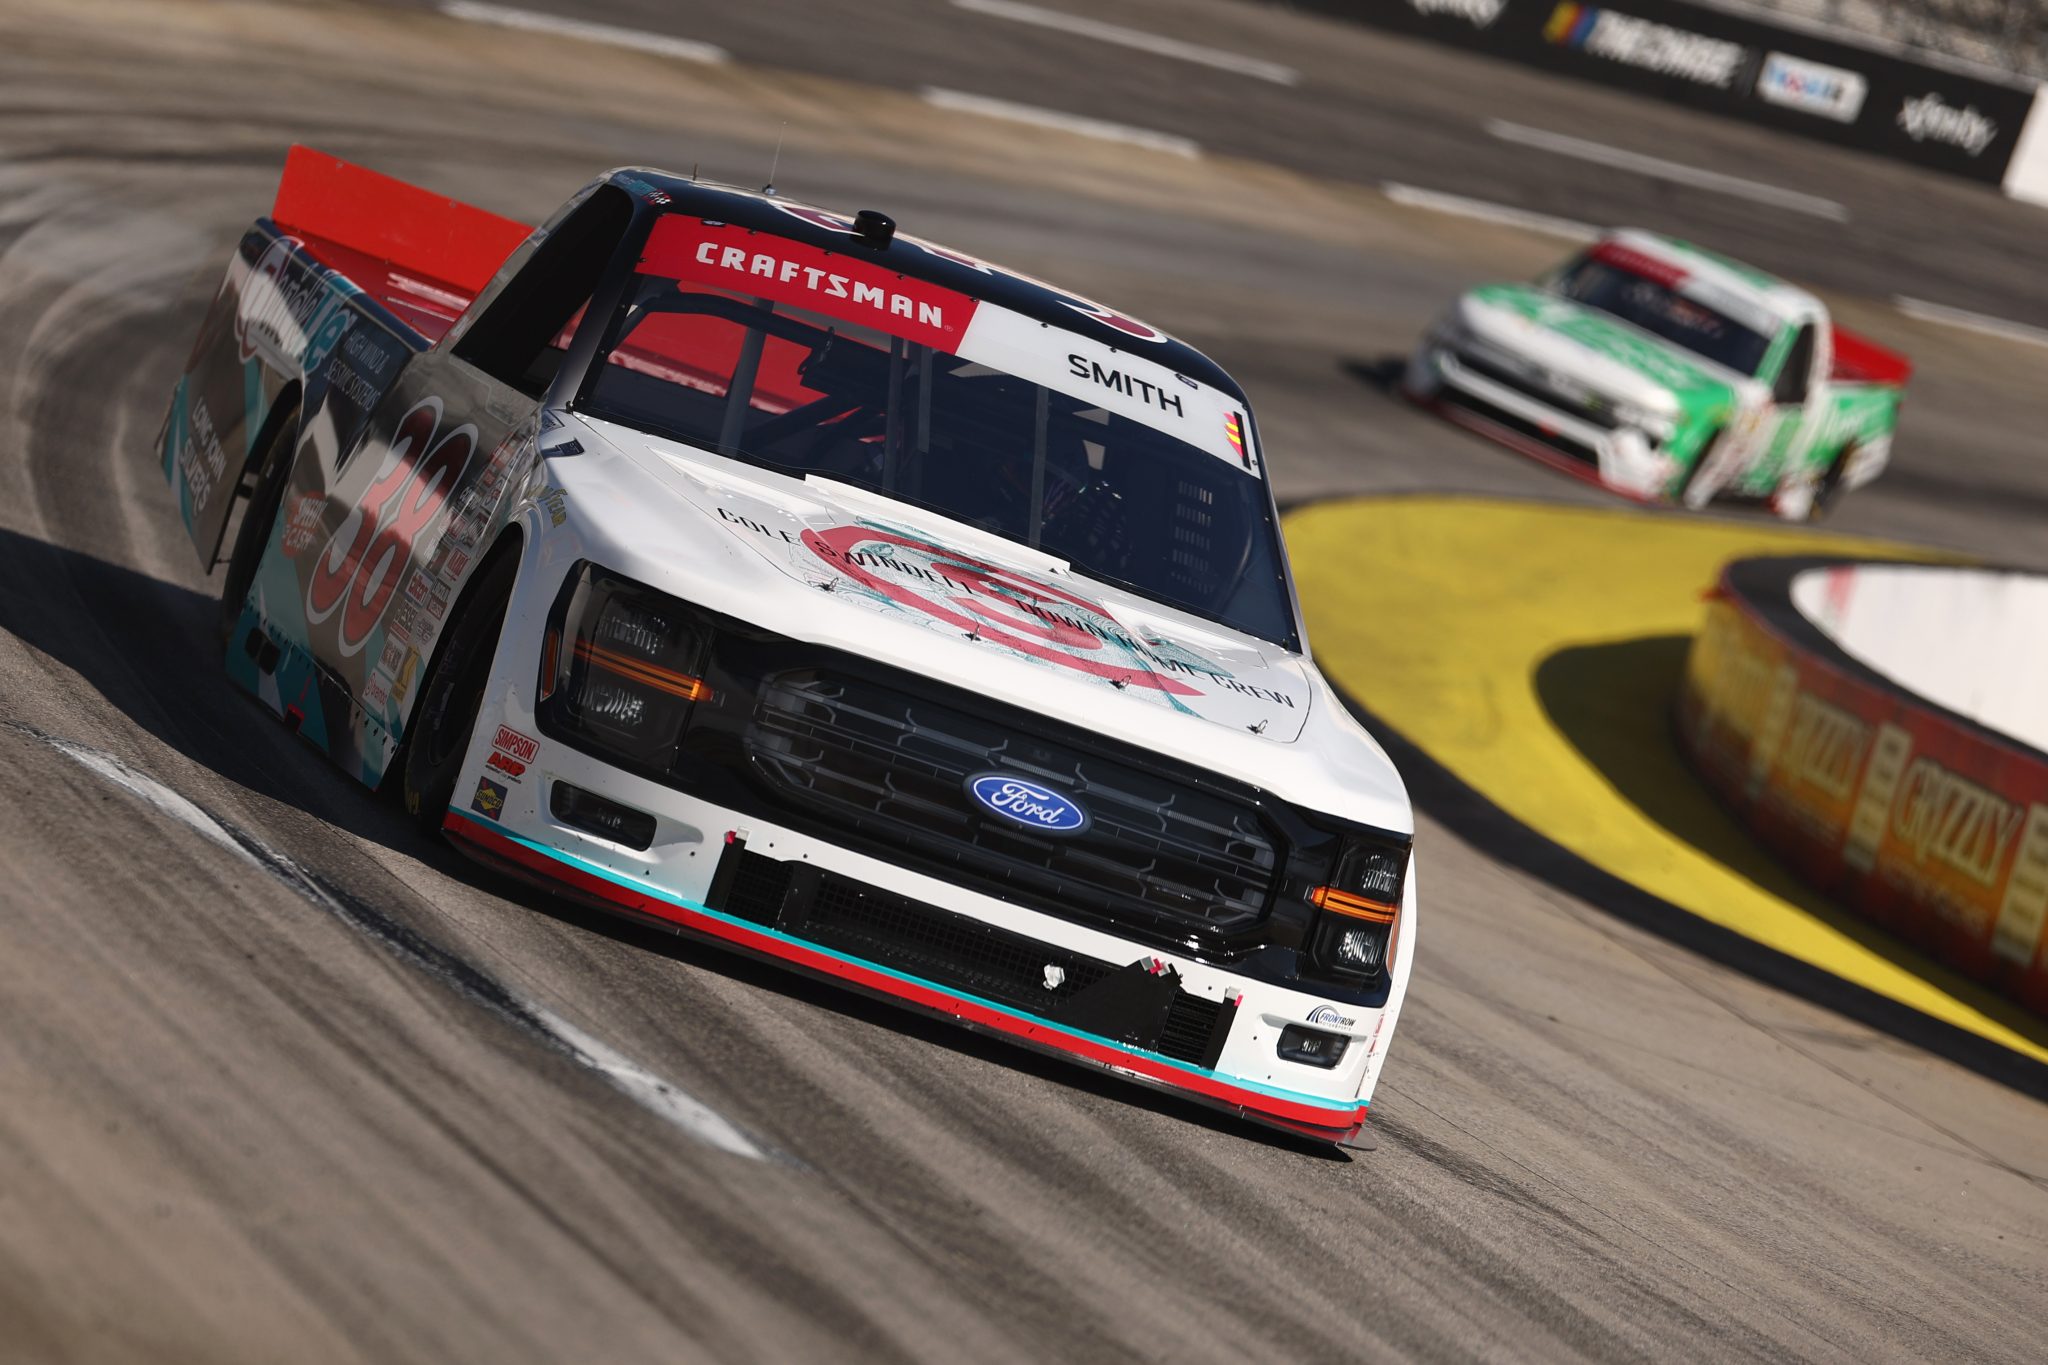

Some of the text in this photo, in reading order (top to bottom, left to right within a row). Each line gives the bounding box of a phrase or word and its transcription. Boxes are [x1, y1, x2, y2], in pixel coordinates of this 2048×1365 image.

[695, 241, 943, 329] CRAFTSMAN
[1067, 353, 1184, 419] SMITH
[306, 395, 480, 658] 38
[716, 506, 801, 547] COLE
[813, 539, 983, 598] SWINDELL
[1017, 599, 1108, 640] DOWN
[1207, 672, 1296, 709] CREW
[487, 751, 526, 777] ARP
[494, 728, 536, 762] SIMPSON
[475, 790, 503, 810] SUNOCO
[991, 782, 1065, 824] Ford
[1894, 755, 2024, 888] GRIZZLY
